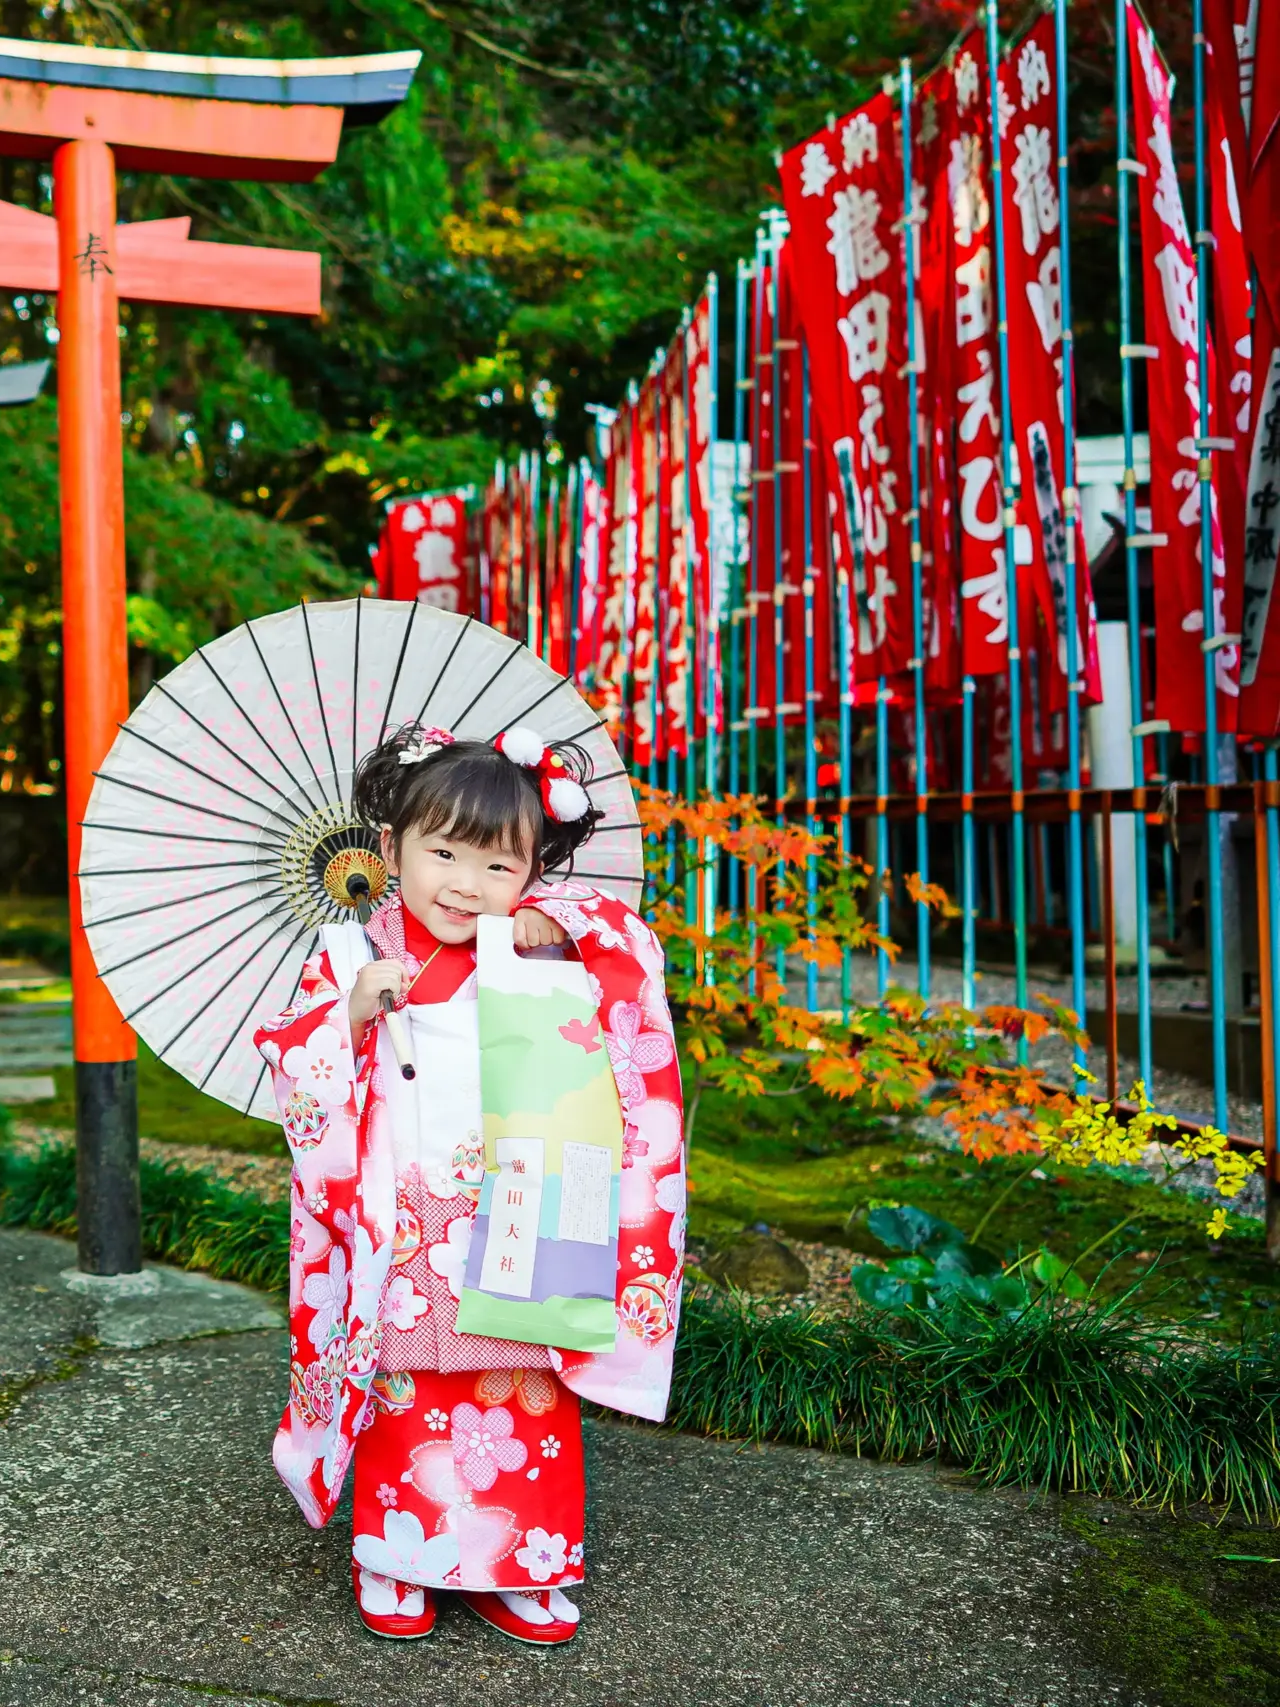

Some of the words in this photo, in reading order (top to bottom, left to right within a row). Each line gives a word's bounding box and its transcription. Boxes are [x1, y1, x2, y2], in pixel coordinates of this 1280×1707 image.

[801, 112, 879, 197] 奉納
[73, 232, 114, 283] 奉
[826, 183, 898, 648] 龍田えびす
[500, 1159, 526, 1273] 龍田大社
